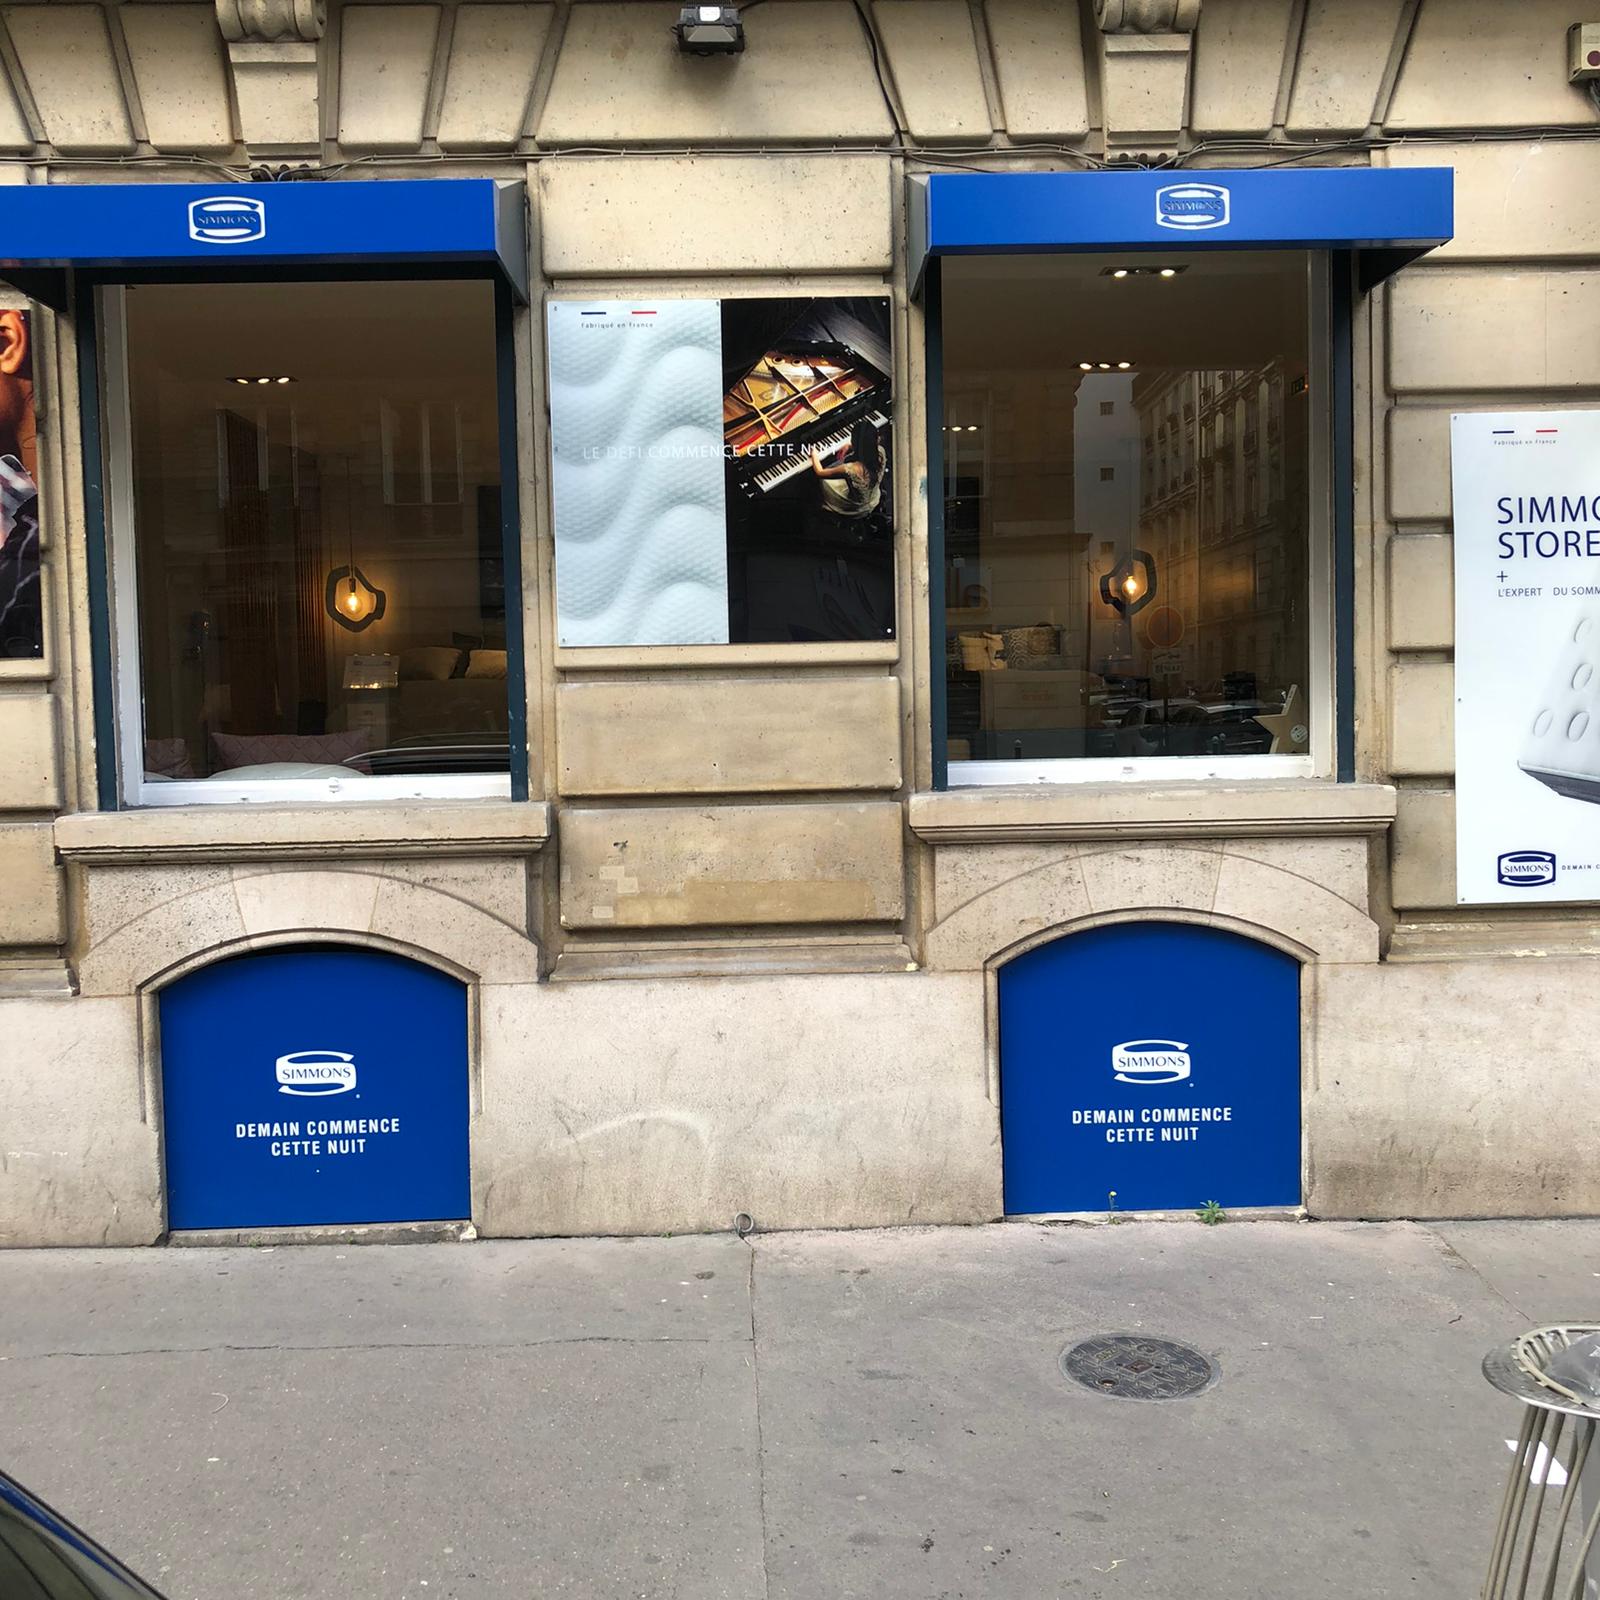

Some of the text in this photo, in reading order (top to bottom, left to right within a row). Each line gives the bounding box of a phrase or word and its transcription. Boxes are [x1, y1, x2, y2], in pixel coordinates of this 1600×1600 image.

[583, 446, 600, 460] LE
[648, 443, 741, 459] COMMENCE
[747, 443, 794, 457] CETTE
[1498, 530, 1600, 559] STORE
[1497, 587, 1543, 598] L'EXPERT
[1553, 586, 1568, 596] DU
[1504, 864, 1550, 873] SIMMONS
[1118, 1055, 1186, 1068] SIMMONS
[282, 1067, 351, 1080] SIMMONS
[1072, 1107, 1232, 1124] DEMAIN COMMENCE
[236, 1118, 400, 1138] DEMAIN COMMENCE
[1106, 1126, 1199, 1143] CETTE NUIT
[271, 1138, 367, 1157] CETTE NUIT
